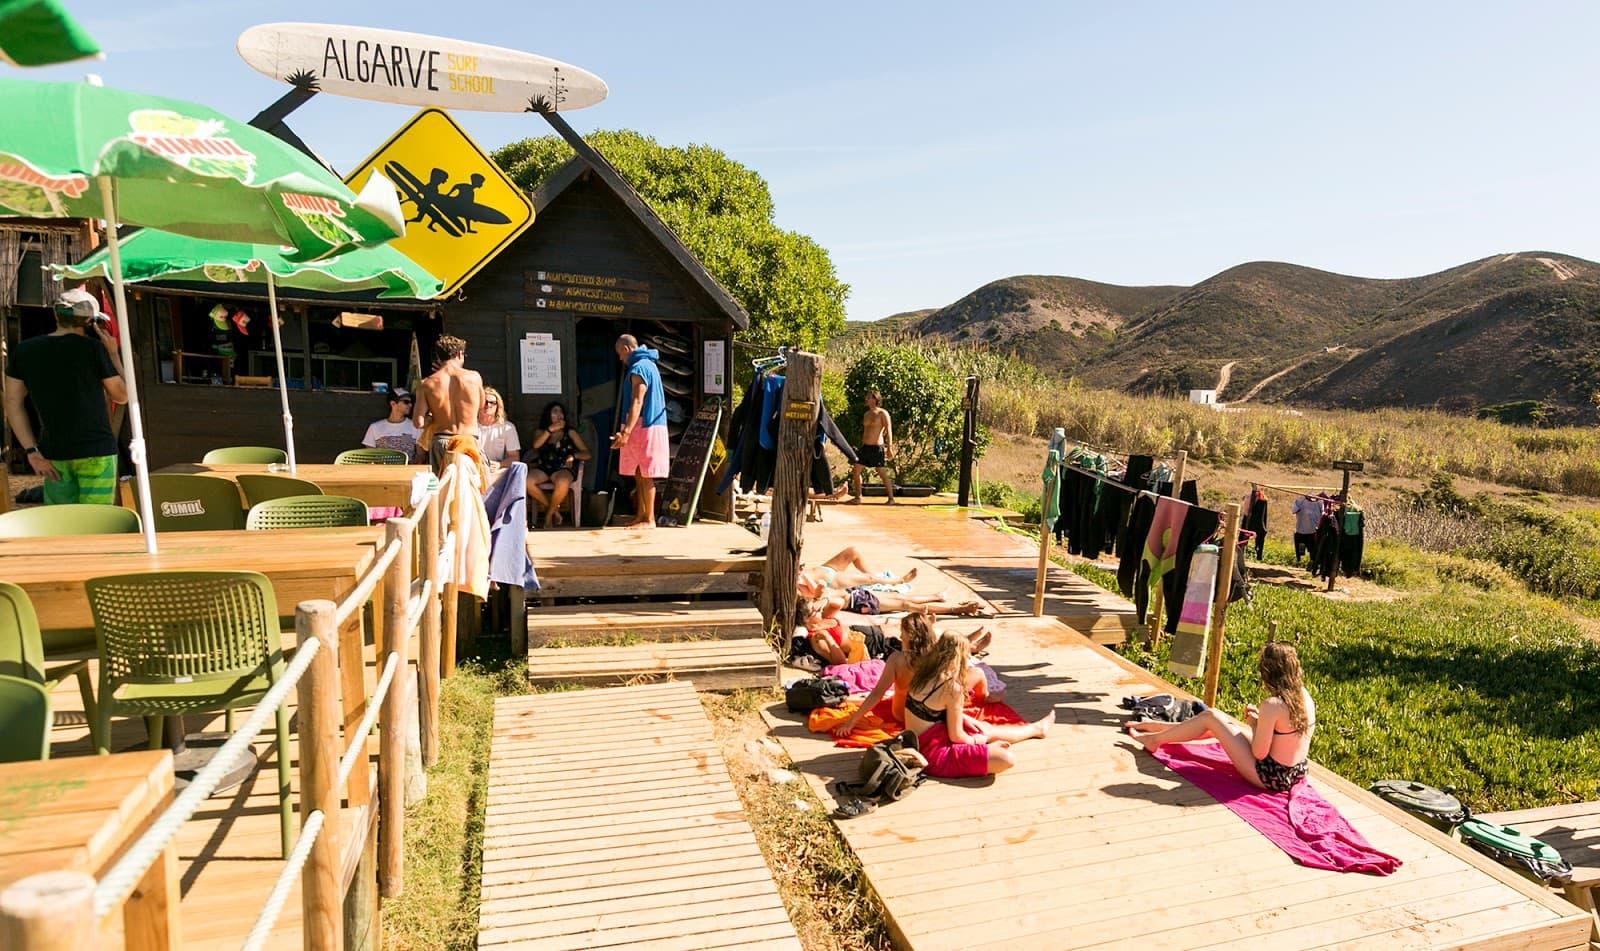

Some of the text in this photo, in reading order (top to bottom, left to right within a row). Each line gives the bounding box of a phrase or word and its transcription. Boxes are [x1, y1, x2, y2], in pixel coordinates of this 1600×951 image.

[322, 37, 441, 91] ALGARVE
[447, 53, 479, 72] SURF
[448, 73, 496, 95] SCHOOL
[161, 500, 205, 517] SUMOL
